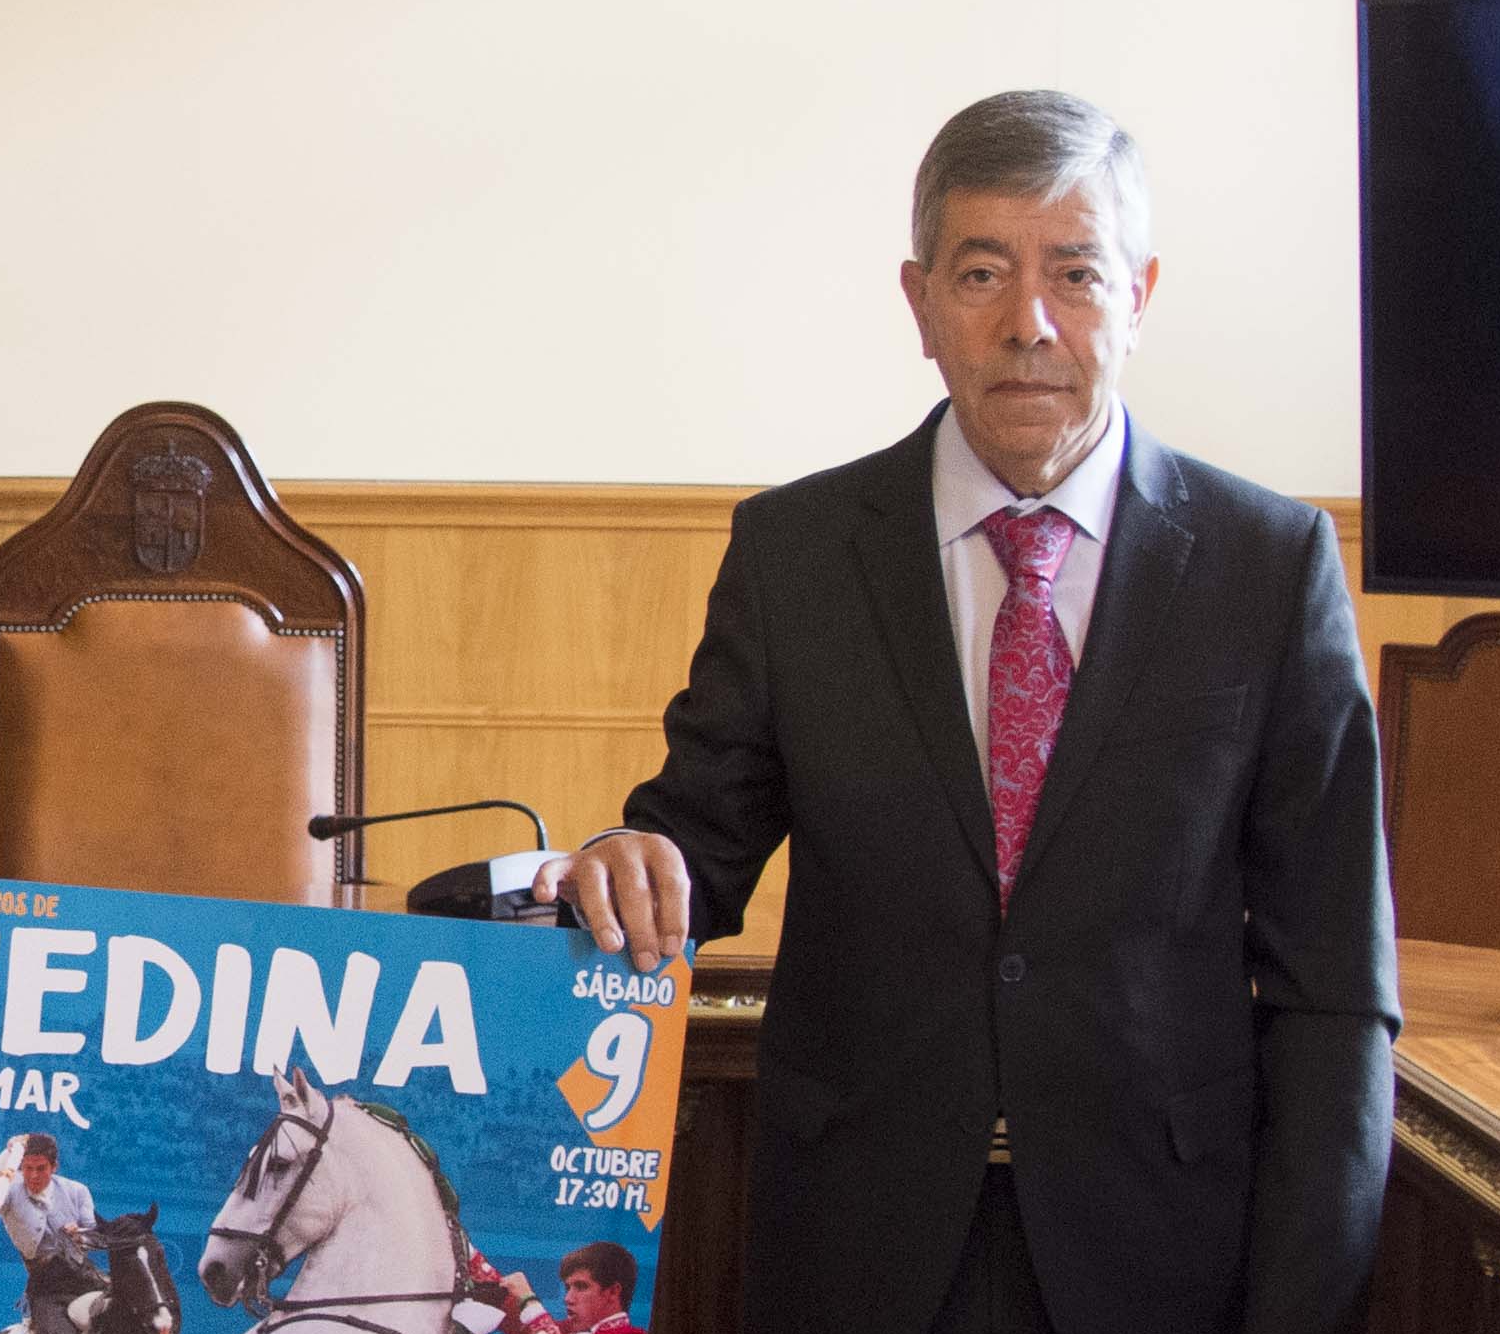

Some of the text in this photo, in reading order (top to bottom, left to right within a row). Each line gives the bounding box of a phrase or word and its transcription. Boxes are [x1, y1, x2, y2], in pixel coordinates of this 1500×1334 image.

[33, 894, 59, 917] DE
[573, 965, 674, 1010] SÁBADO
[585, 1013, 649, 1130] 9
[551, 1145, 660, 1179] OCTUBRE
[555, 1178, 652, 1212] 17:30 H.
